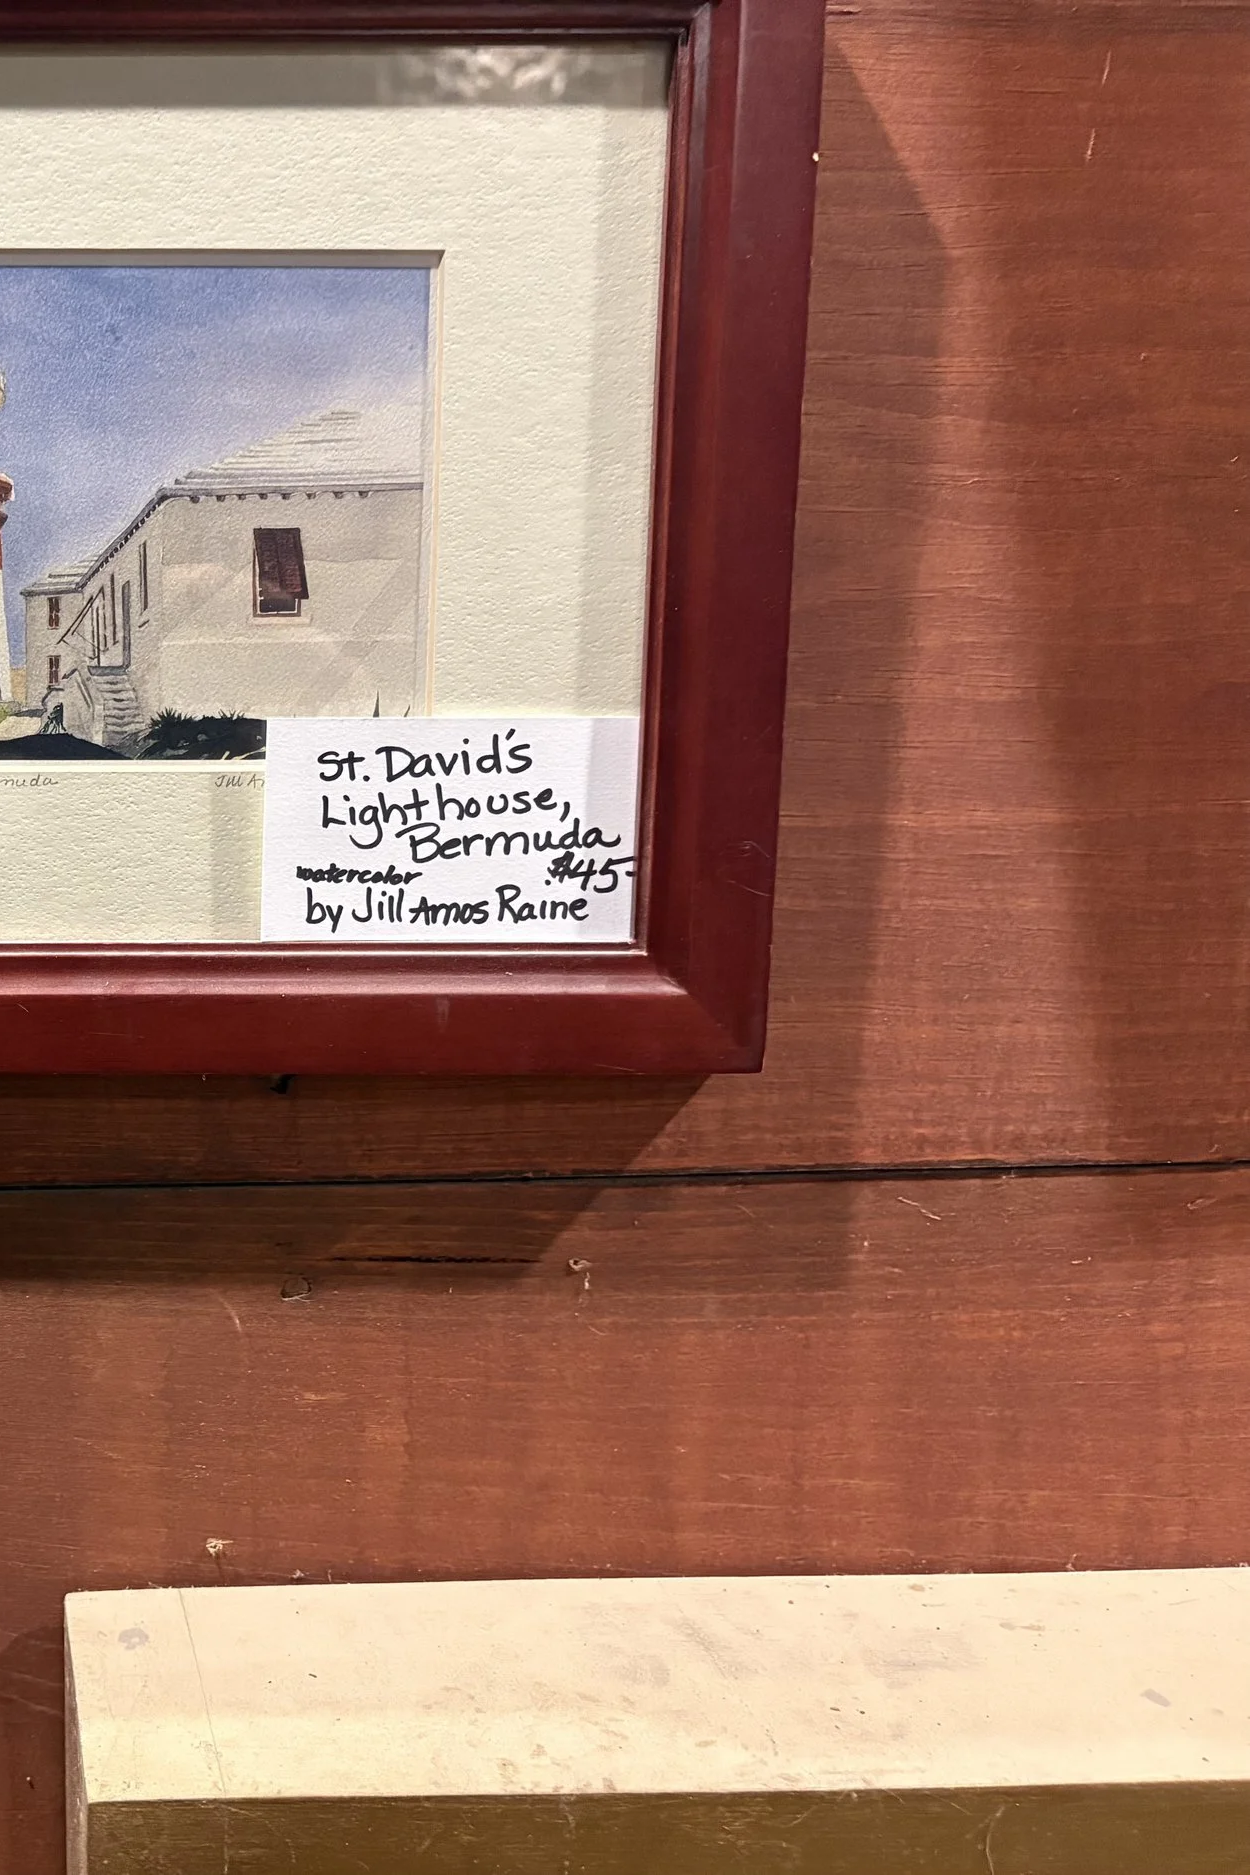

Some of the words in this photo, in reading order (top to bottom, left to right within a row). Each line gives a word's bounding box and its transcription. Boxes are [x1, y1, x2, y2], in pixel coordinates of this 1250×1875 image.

[317, 750, 370, 782] St.
[375, 728, 533, 782] David's
[321, 783, 571, 849] Lighthouse,
[395, 818, 622, 864] Bermuda
[295, 862, 424, 886] watercolor
[305, 886, 344, 933] by
[351, 887, 405, 924] Jill
[408, 896, 490, 926] Amos
[494, 884, 590, 924] Raine
